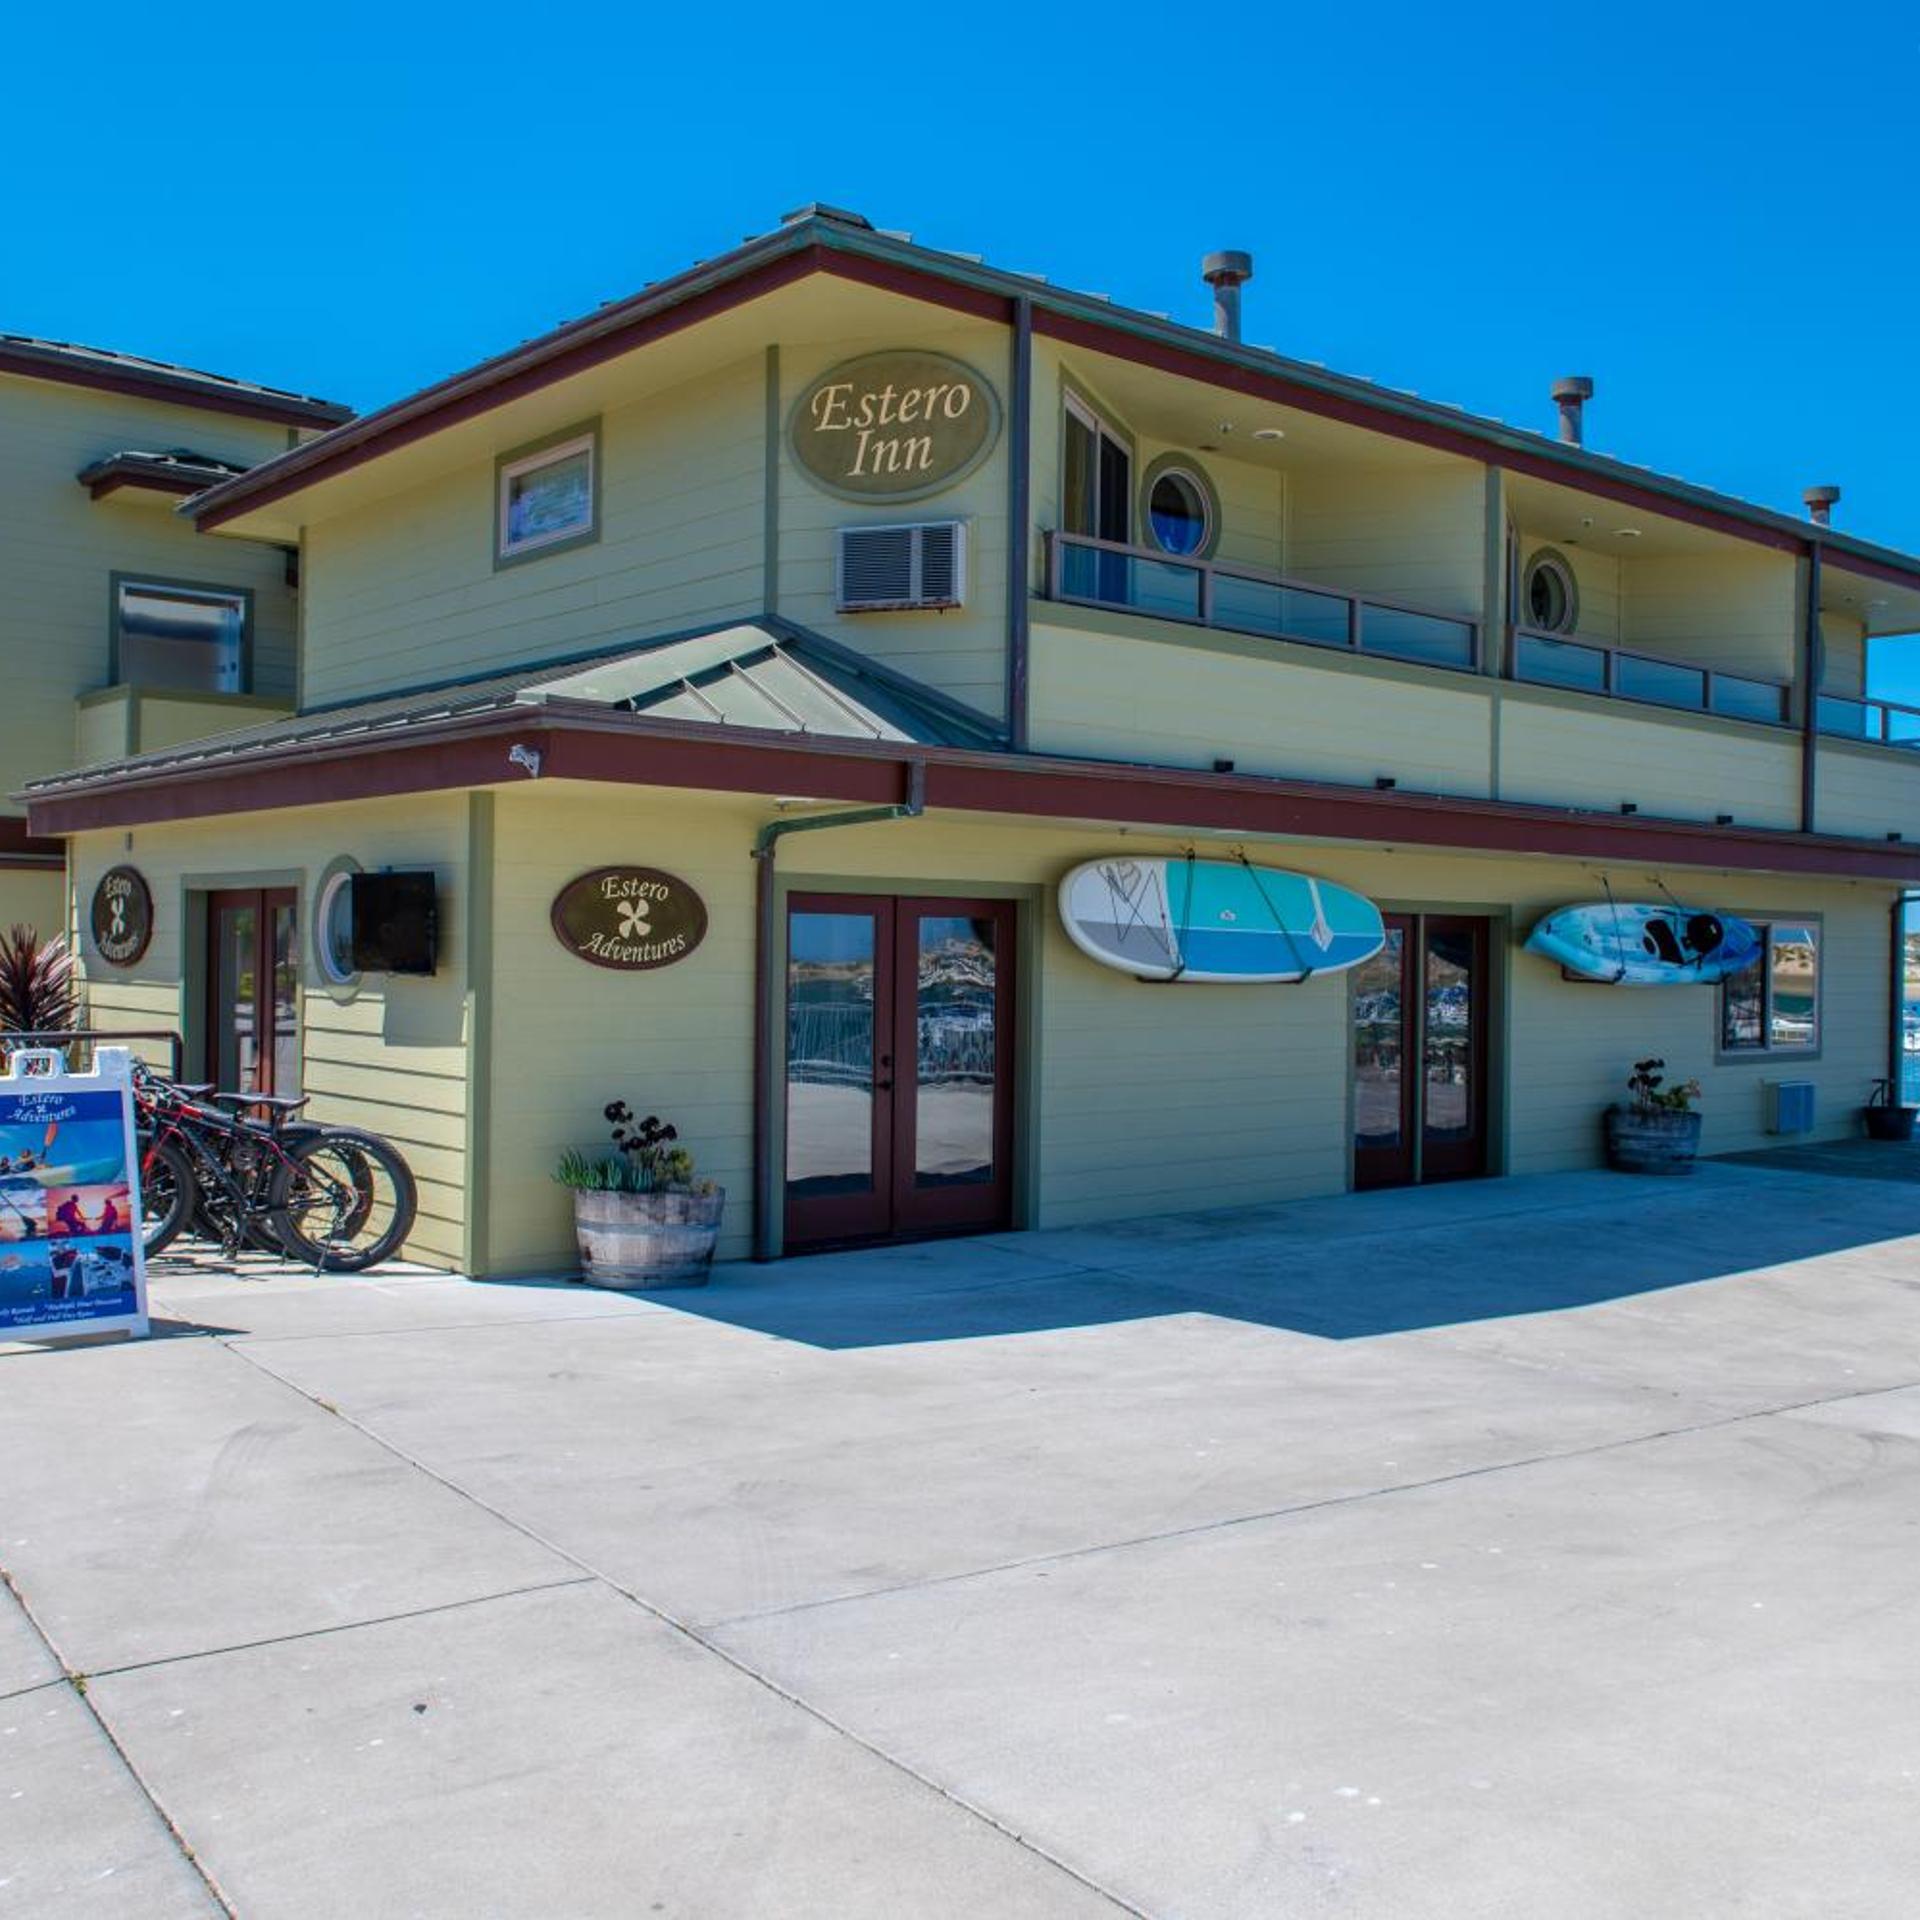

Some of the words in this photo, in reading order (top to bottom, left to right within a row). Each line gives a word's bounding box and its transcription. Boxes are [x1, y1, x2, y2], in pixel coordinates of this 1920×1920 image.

[811, 383, 970, 431] Estero
[847, 429, 934, 476] Inn
[601, 875, 669, 901] Estero
[579, 932, 686, 962] Adventures
